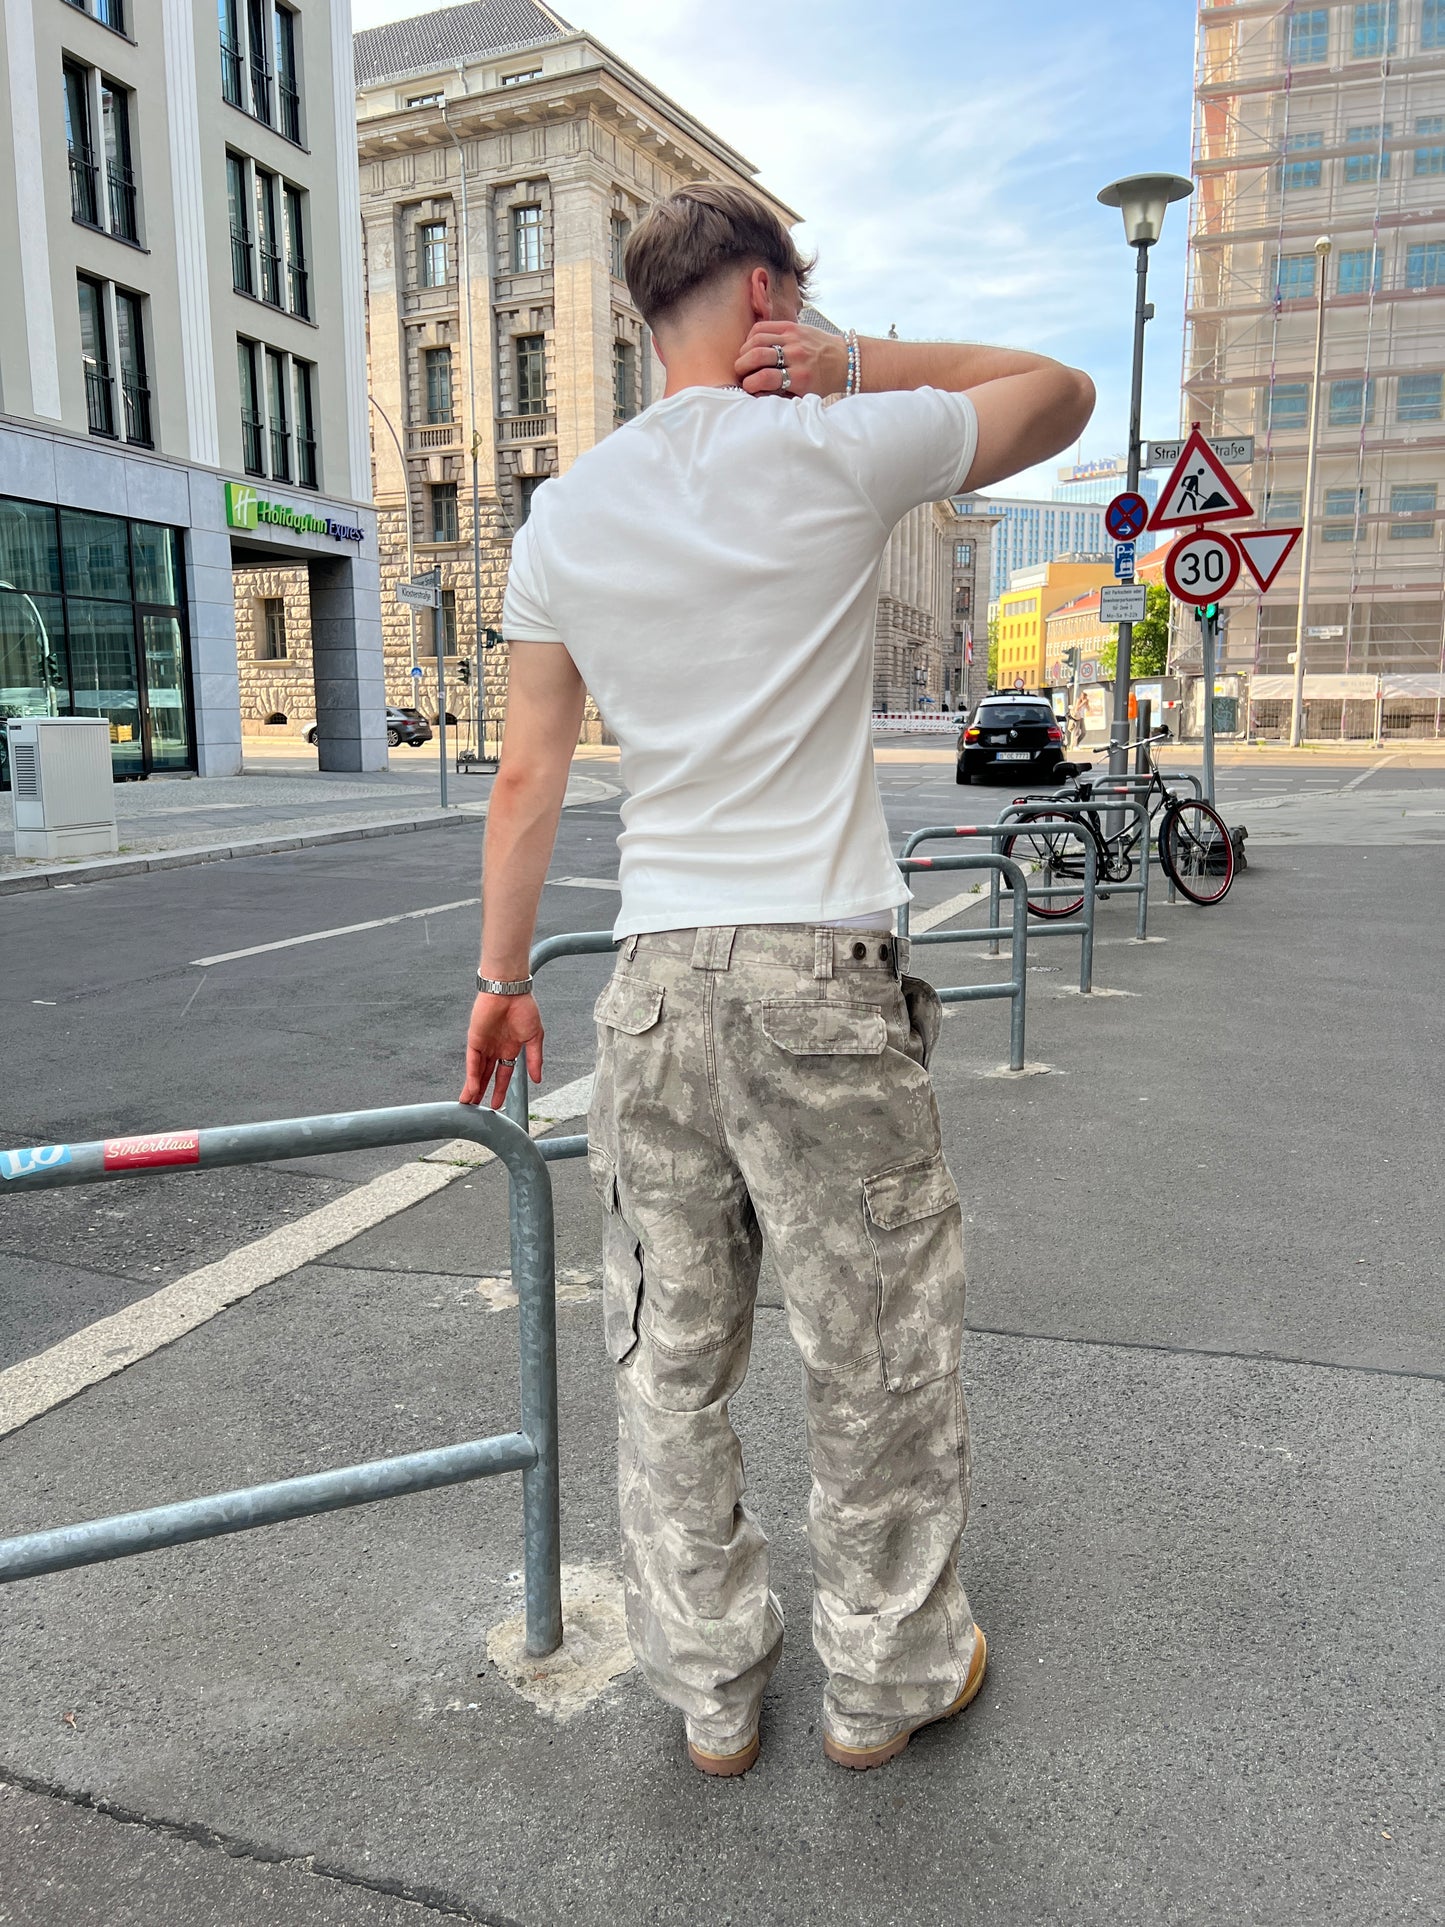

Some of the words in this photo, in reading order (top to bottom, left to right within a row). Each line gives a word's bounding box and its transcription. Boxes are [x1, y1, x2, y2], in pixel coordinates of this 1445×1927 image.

[1155, 446, 1180, 460] Stral
[1211, 443, 1245, 458] traße
[259, 502, 308, 534] Holiday
[308, 514, 327, 534] Inn
[1181, 549, 1224, 586] 30
[402, 587, 432, 602] Klosterstraße
[105, 1138, 195, 1158] Sinterklaus
